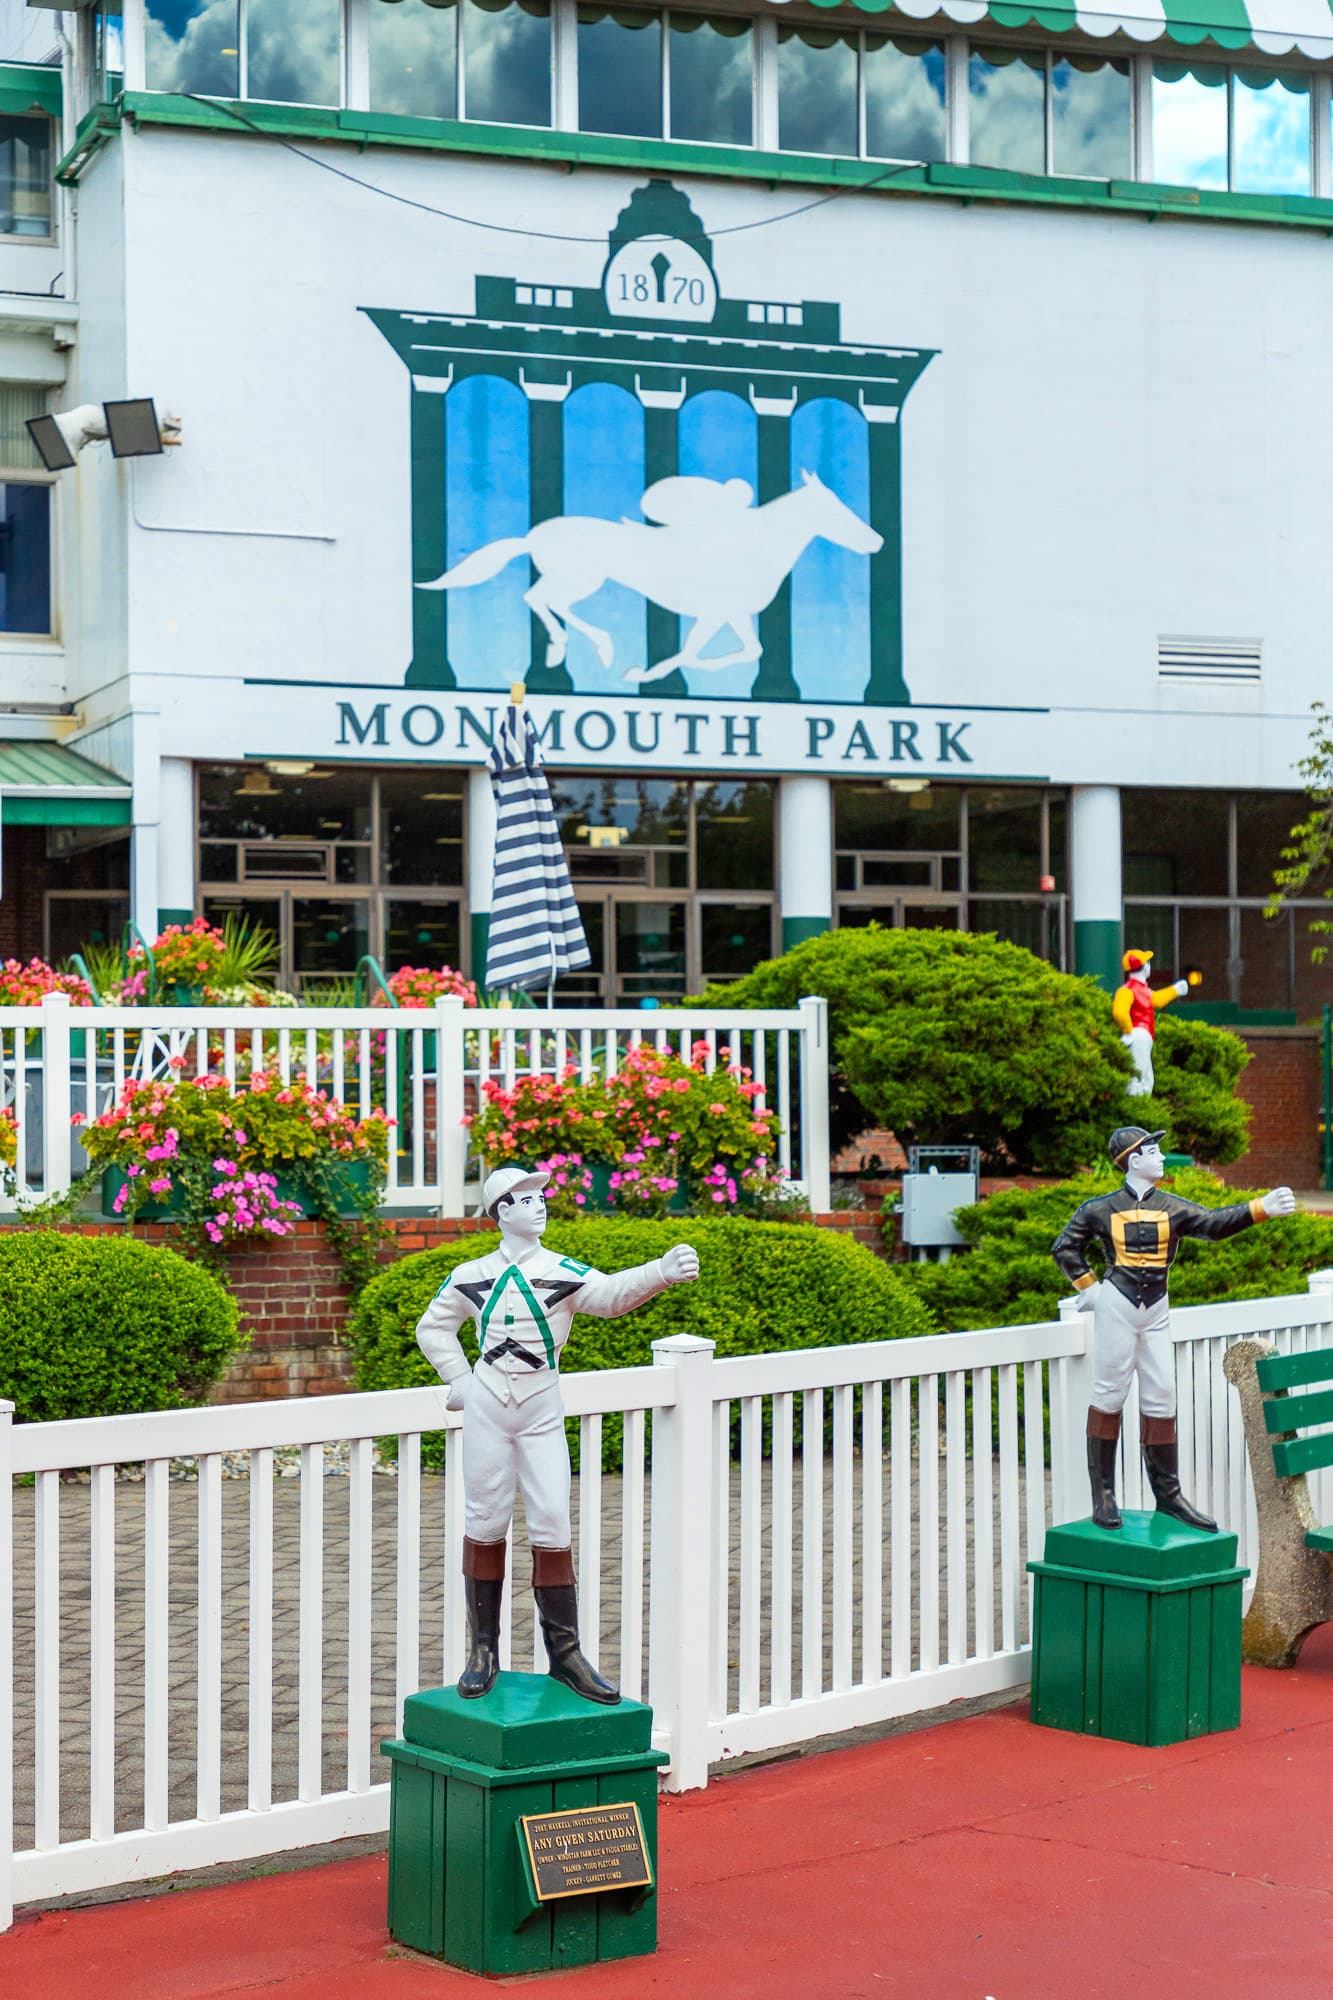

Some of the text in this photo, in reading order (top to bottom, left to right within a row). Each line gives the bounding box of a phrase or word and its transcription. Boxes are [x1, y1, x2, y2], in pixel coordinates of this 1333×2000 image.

[335, 701, 974, 763] MONMOUTH PARK
[549, 1820, 571, 1831] HASKELL
[572, 1816, 608, 1828] INVITATIONAL
[609, 1813, 629, 1823] WINNER
[534, 1826, 636, 1851] ANY GIVEN SATURDAY
